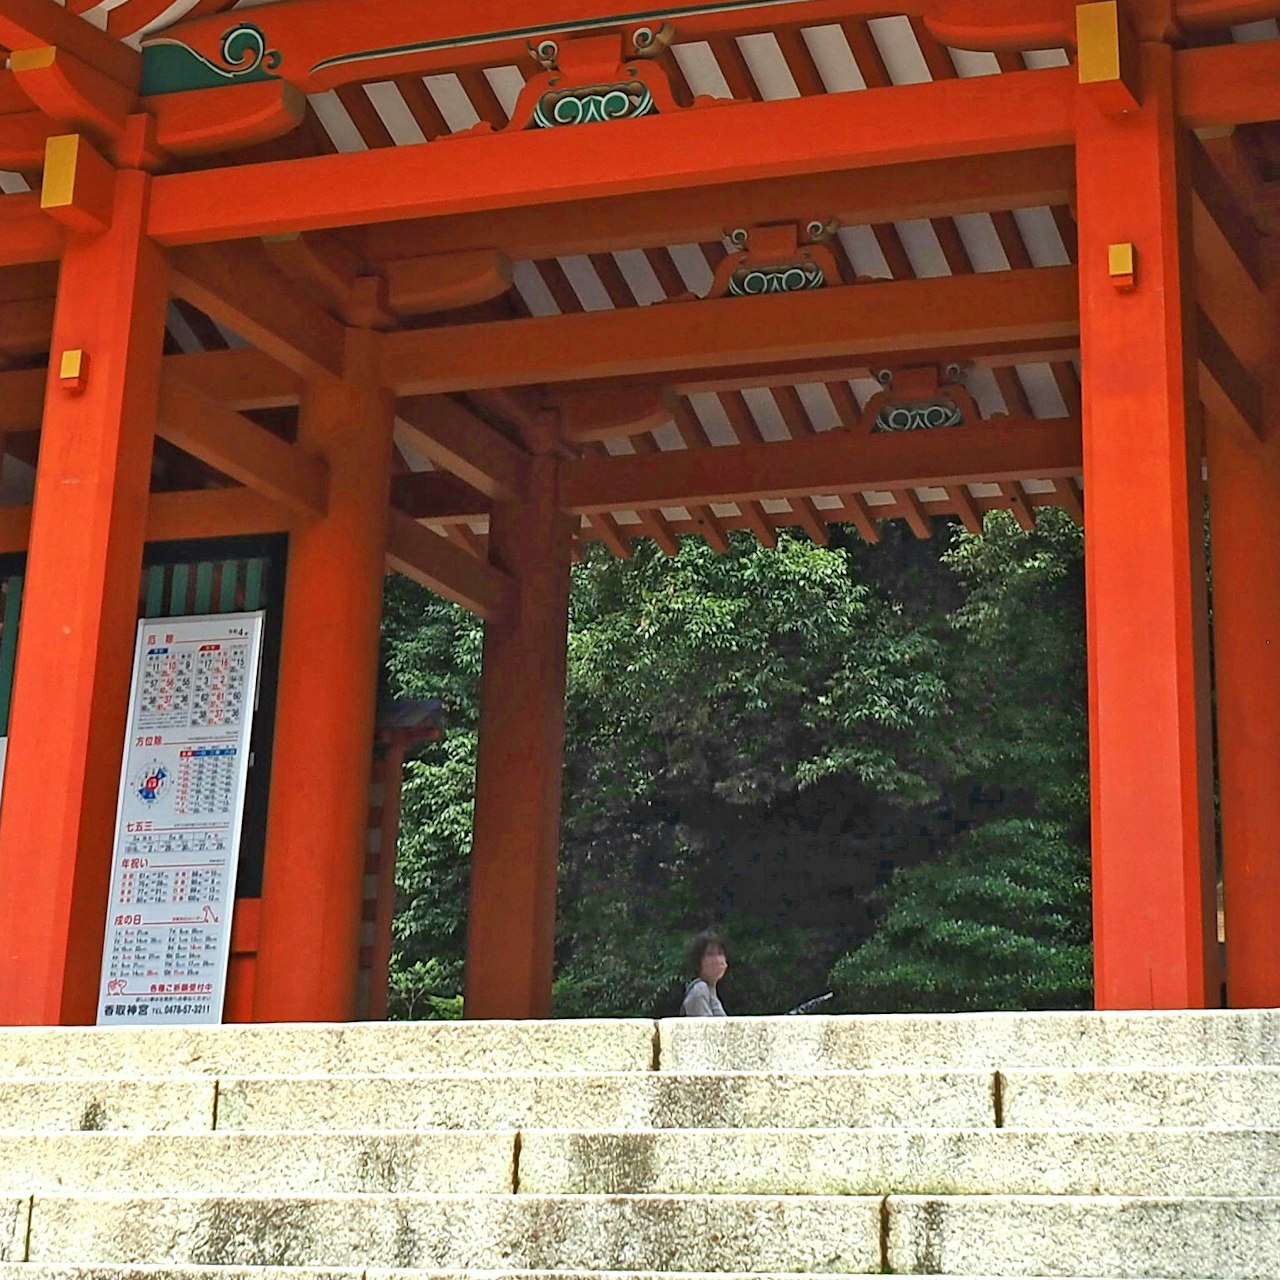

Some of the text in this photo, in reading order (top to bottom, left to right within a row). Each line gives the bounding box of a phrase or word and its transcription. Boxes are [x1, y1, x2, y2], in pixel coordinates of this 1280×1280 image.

[127, 821, 152, 832] 七五三
[121, 858, 148, 869] 年祝い
[115, 914, 141, 925] 戌の日
[104, 1004, 149, 1016] 香取神宮
